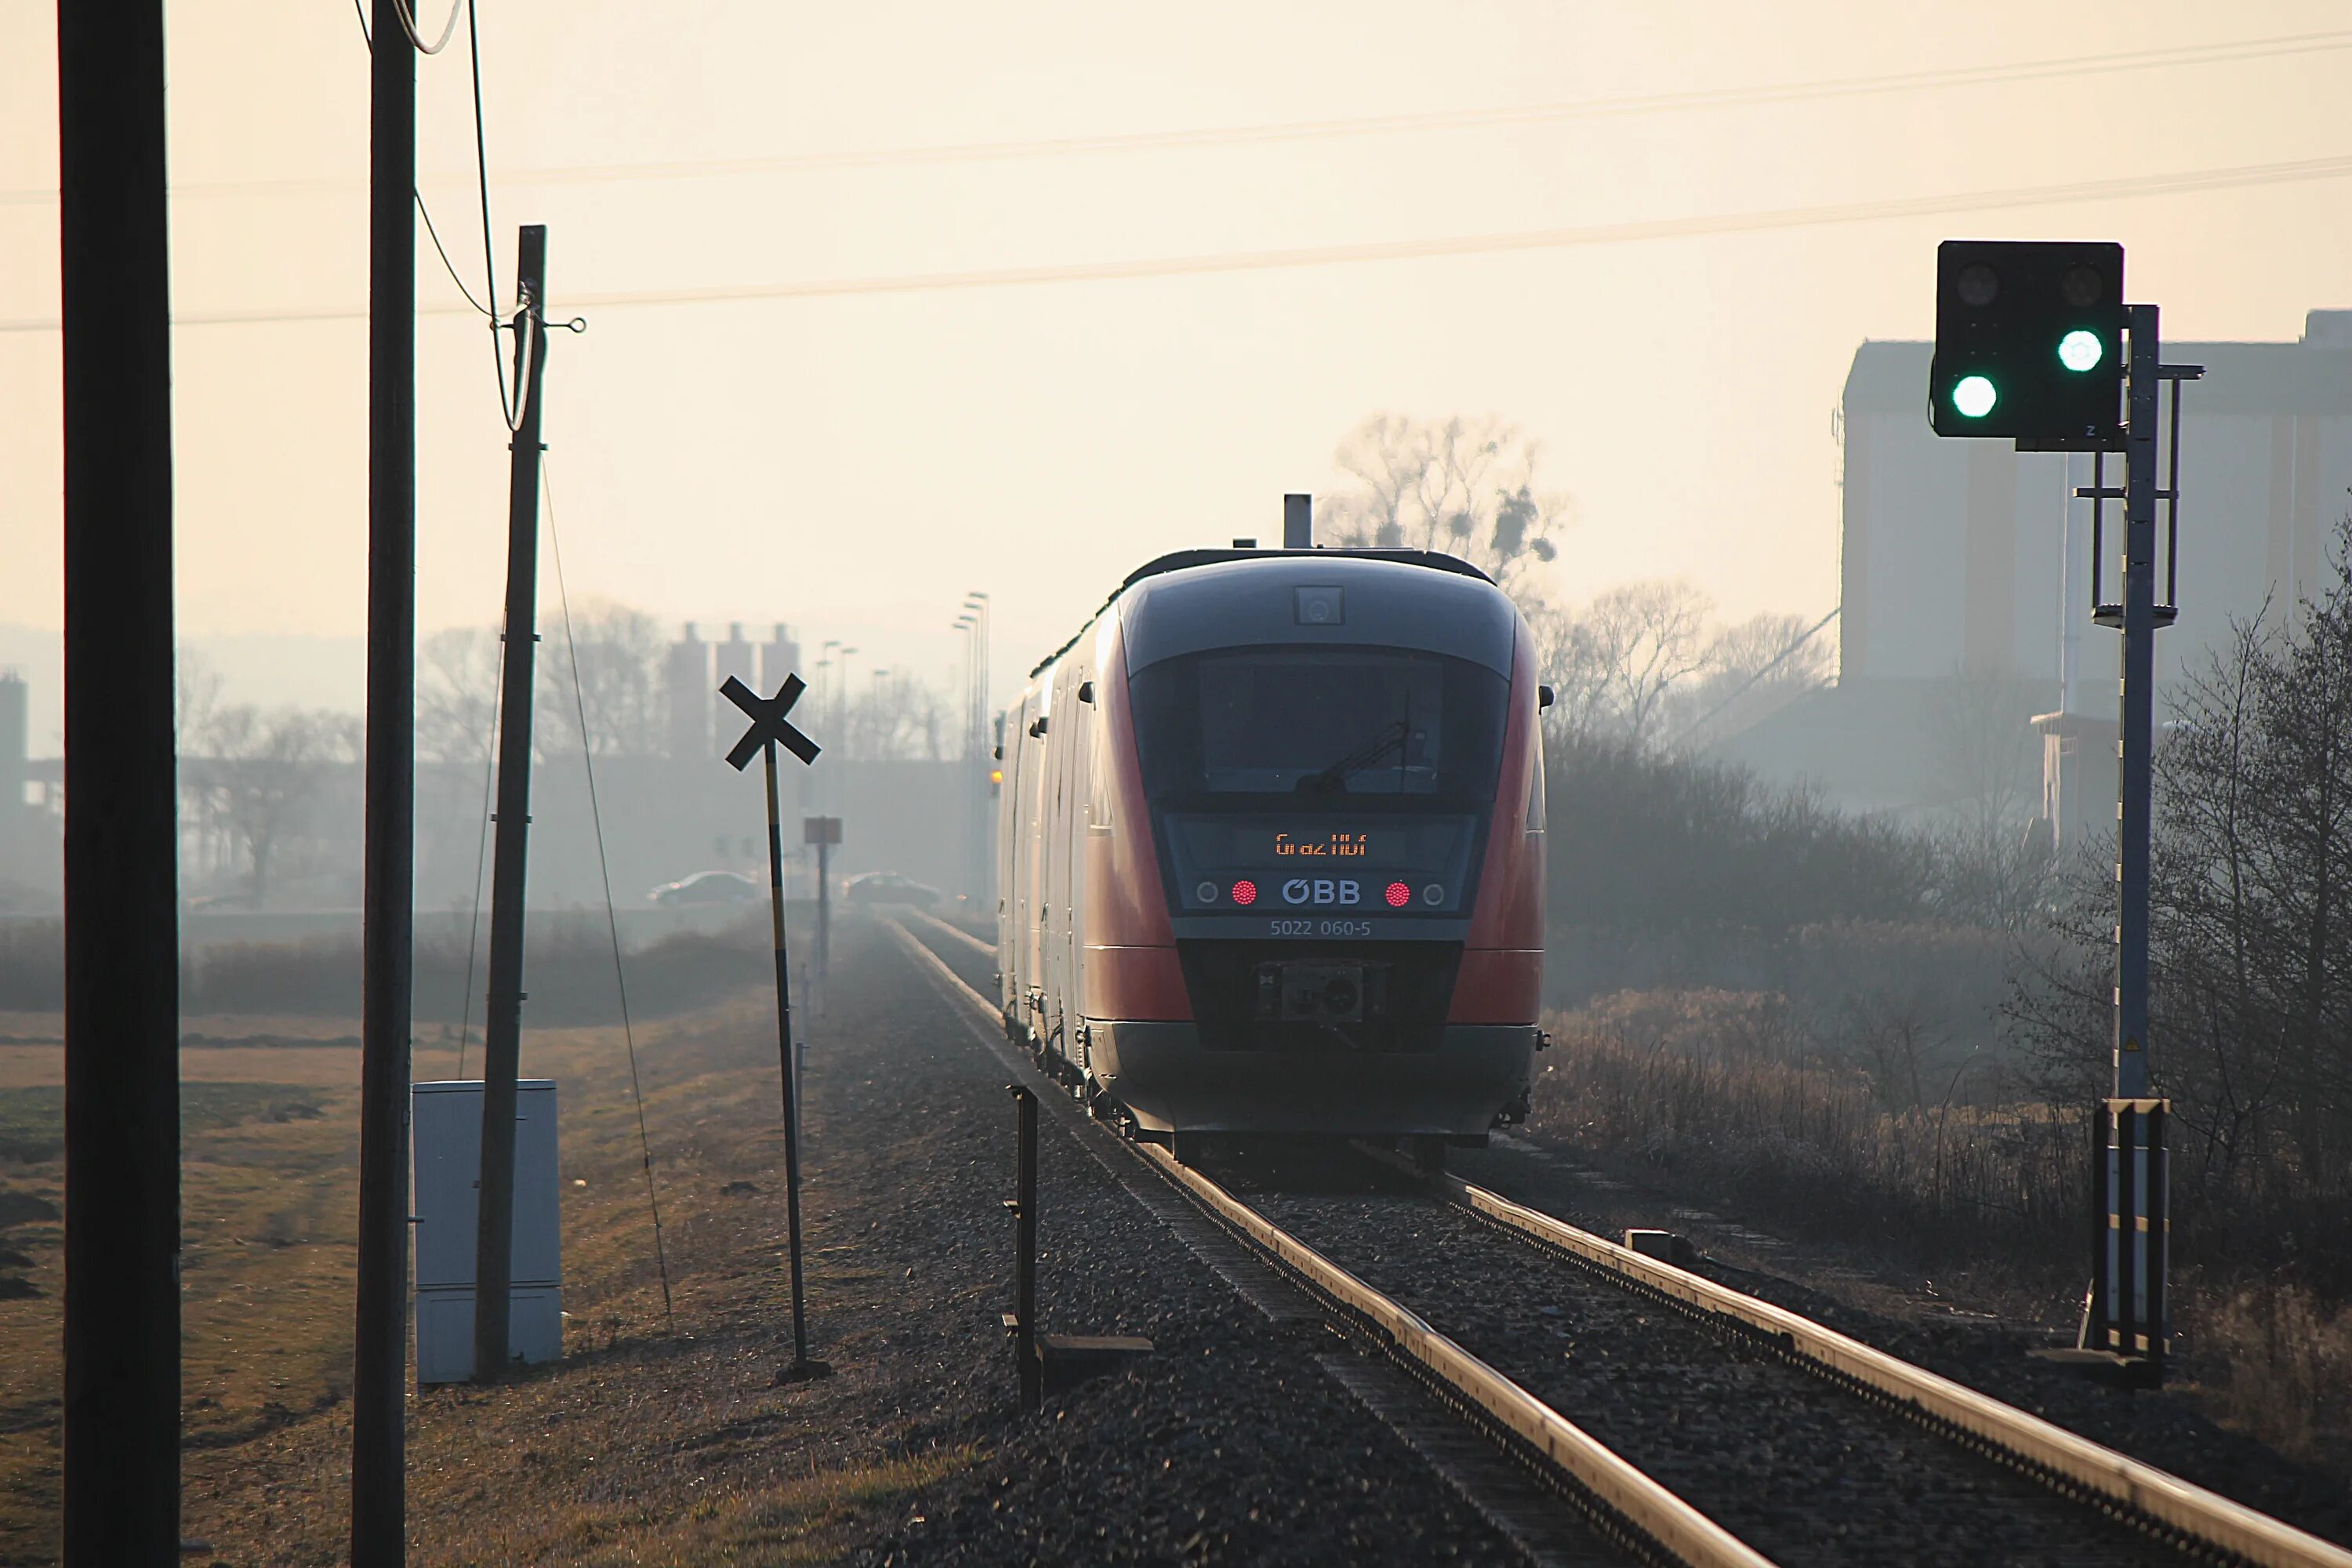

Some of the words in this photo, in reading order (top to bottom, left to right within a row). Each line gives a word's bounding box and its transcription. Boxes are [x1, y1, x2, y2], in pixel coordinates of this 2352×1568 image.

[1276, 833, 1327, 855] Graz
[1282, 879, 1360, 904] ÖBB
[1271, 920, 1312, 935] 5022
[1320, 920, 1370, 935] 060-5
